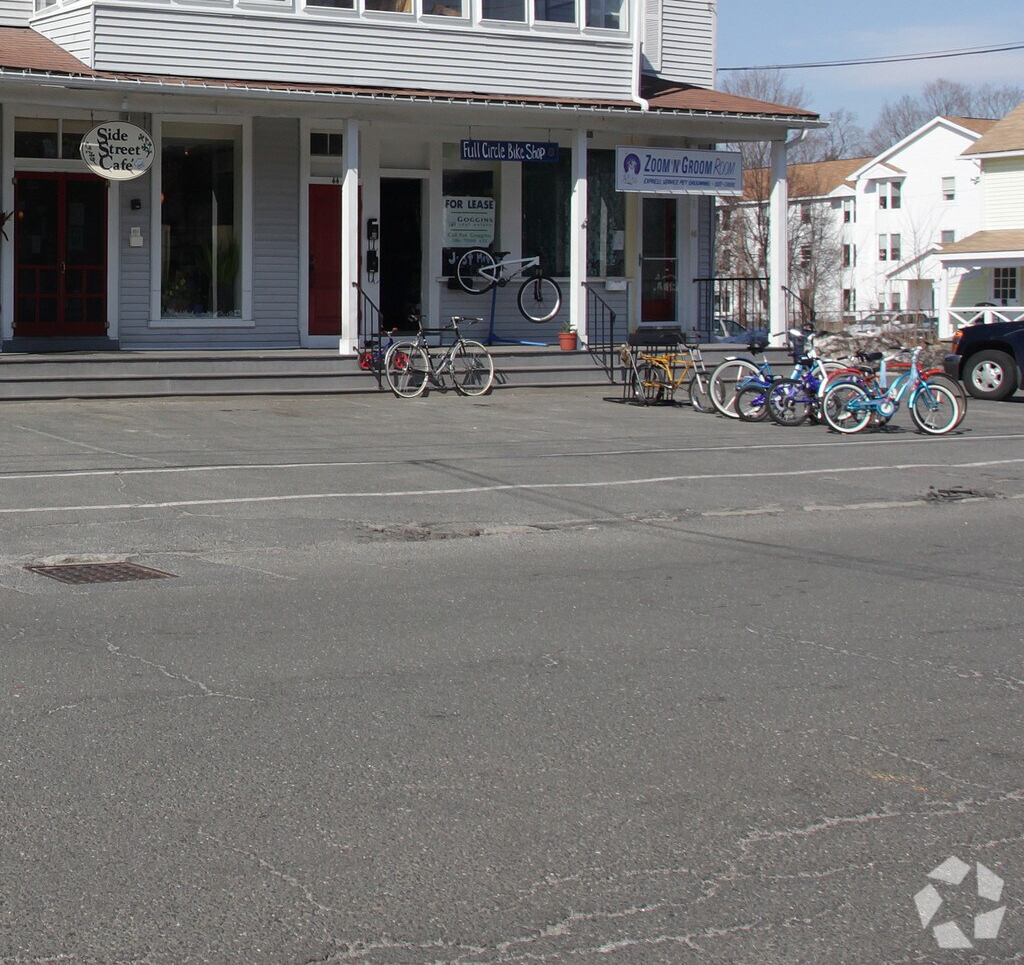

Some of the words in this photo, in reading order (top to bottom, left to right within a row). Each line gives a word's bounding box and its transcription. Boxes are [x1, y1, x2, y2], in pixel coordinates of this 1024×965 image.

[97, 128, 128, 143] Side
[98, 141, 142, 156] Street
[463, 141, 480, 158] Full
[482, 142, 506, 159] Circle
[508, 143, 525, 160] Bike
[644, 154, 671, 173] ZOOM
[681, 156, 713, 175] GROOM
[712, 158, 736, 176] ROOM
[445, 199, 463, 209] FOR
[467, 200, 494, 209] LEASE
